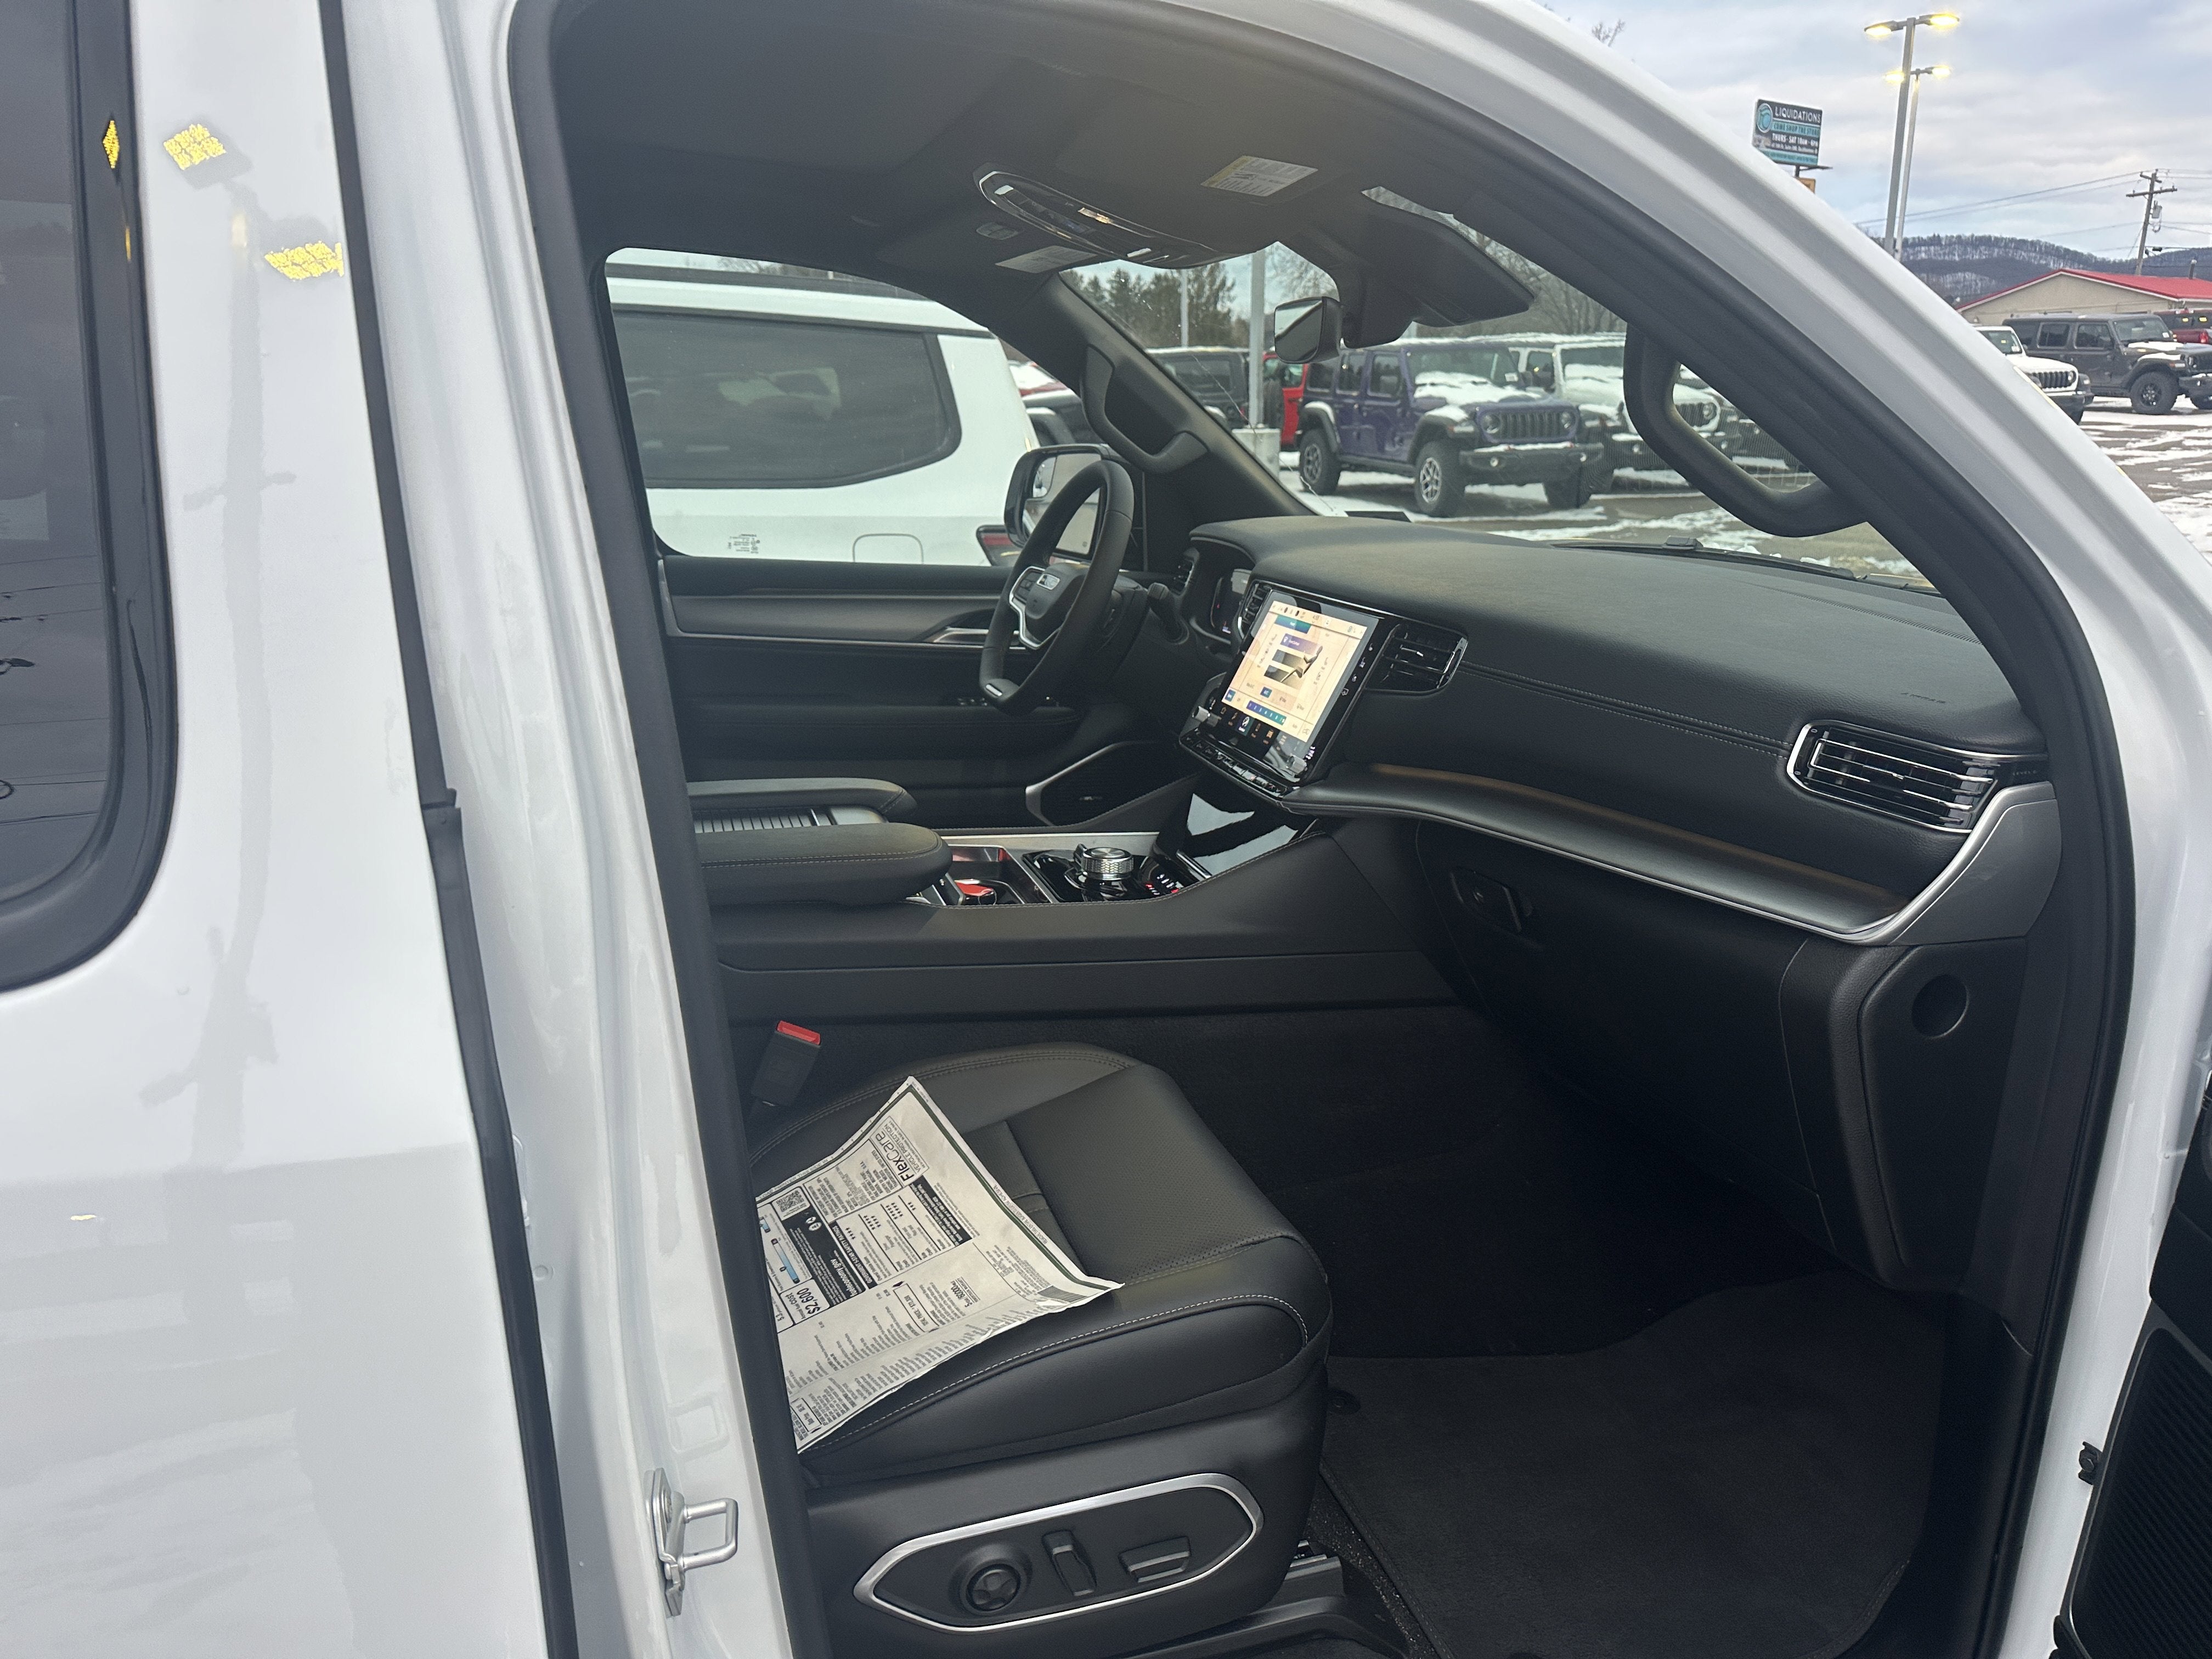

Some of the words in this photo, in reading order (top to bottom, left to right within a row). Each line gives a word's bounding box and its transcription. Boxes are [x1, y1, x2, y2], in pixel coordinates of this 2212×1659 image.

[1775, 107, 1821, 123] LIQUIDATIONS
[883, 1123, 909, 1153] PROTECTION
[874, 1132, 915, 1182] FlexCare
[904, 1152, 922, 1172] VEHICLE
[831, 1224, 844, 1240] RATINGS
[840, 1238, 853, 1253] SAFETY
[848, 1251, 859, 1264] 5-STAR
[901, 1259, 910, 1268] Crash
[855, 1261, 873, 1284] GOVERNMENT
[867, 1262, 876, 1273] Vehicle
[831, 1258, 858, 1297] fueleconomy.gov
[872, 1271, 882, 1282] Overall
[956, 1277, 968, 1289] WARRANTY
[785, 1292, 798, 1305] cost
[795, 1286, 821, 1316] $2,600
[966, 1289, 979, 1302] POWERTRAIN
[775, 1312, 785, 1322] 5.3
